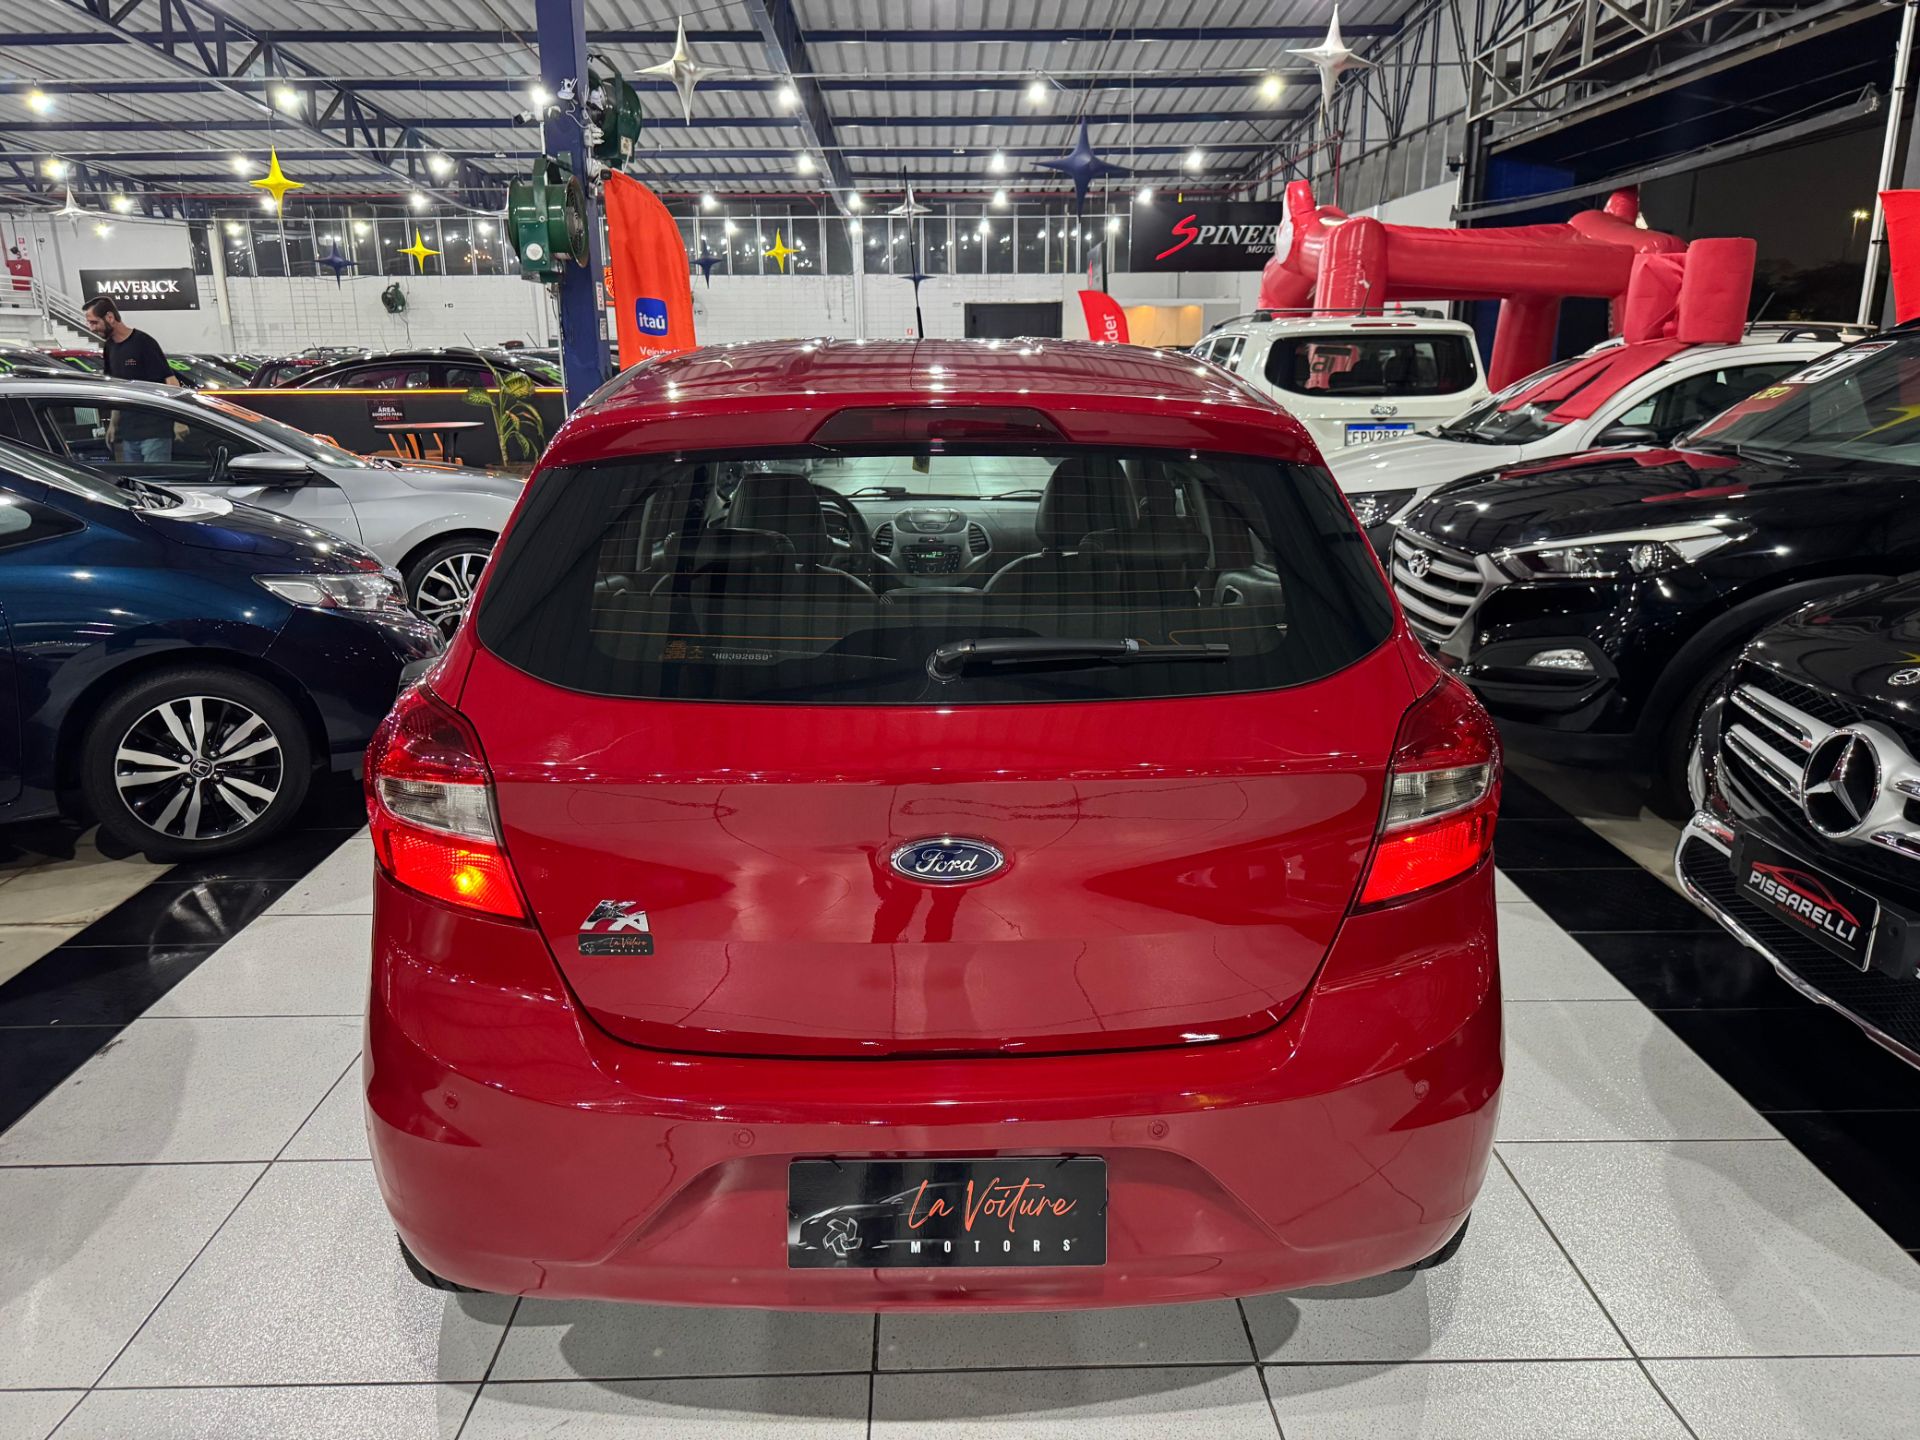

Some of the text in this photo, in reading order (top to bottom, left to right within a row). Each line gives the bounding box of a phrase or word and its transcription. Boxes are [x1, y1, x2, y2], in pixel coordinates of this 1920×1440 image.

[97, 280, 179, 293] MAVERICK
[1371, 404, 1398, 416] Jeep
[916, 848, 980, 873] Ford
[579, 900, 649, 932] KA
[1749, 869, 1857, 942] PISSARELLI
[908, 1176, 1077, 1233] La Voiture
[910, 1239, 1072, 1254] MOTORS
